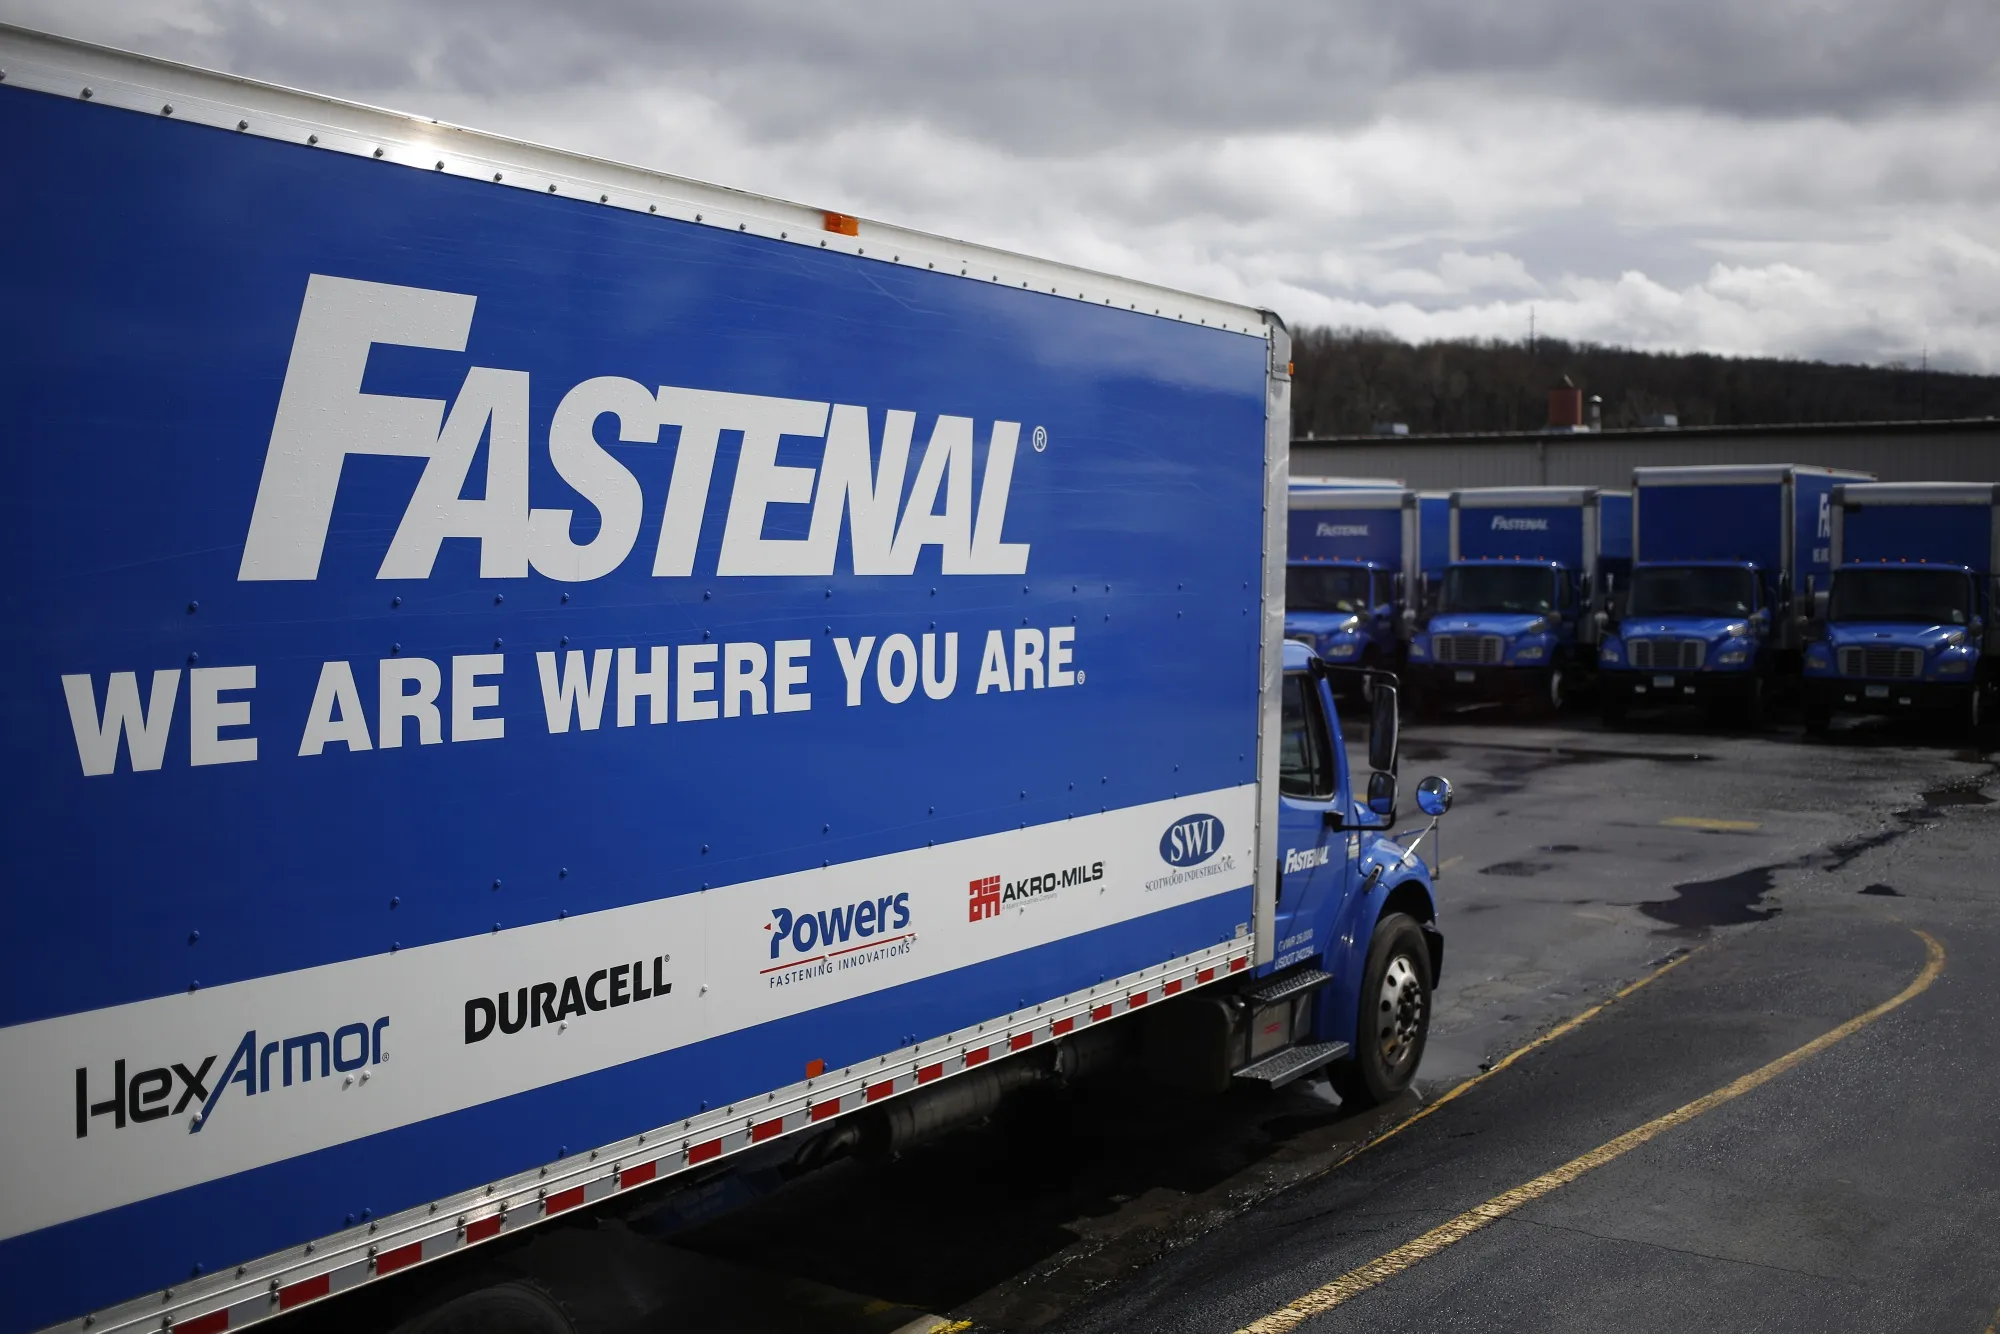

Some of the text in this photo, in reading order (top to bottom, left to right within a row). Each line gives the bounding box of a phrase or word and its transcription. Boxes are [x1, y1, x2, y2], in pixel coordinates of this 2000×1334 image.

[238, 273, 1031, 583] FASTENAL
[61, 665, 258, 777] WE
[298, 653, 505, 757] ARE
[536, 639, 812, 734] WHERE
[833, 631, 959, 707] YOU
[1170, 818, 1215, 863] SWI
[1284, 846, 1330, 874] FASTENAL
[1002, 862, 1103, 903] AKRO-MILS
[1145, 873, 1184, 892] SCOTWOOD
[770, 892, 910, 960] Powers
[770, 943, 911, 989] FASTENING INNOVATIONS
[464, 956, 673, 1045] DURACELL
[76, 1015, 390, 1139] HexArmor
